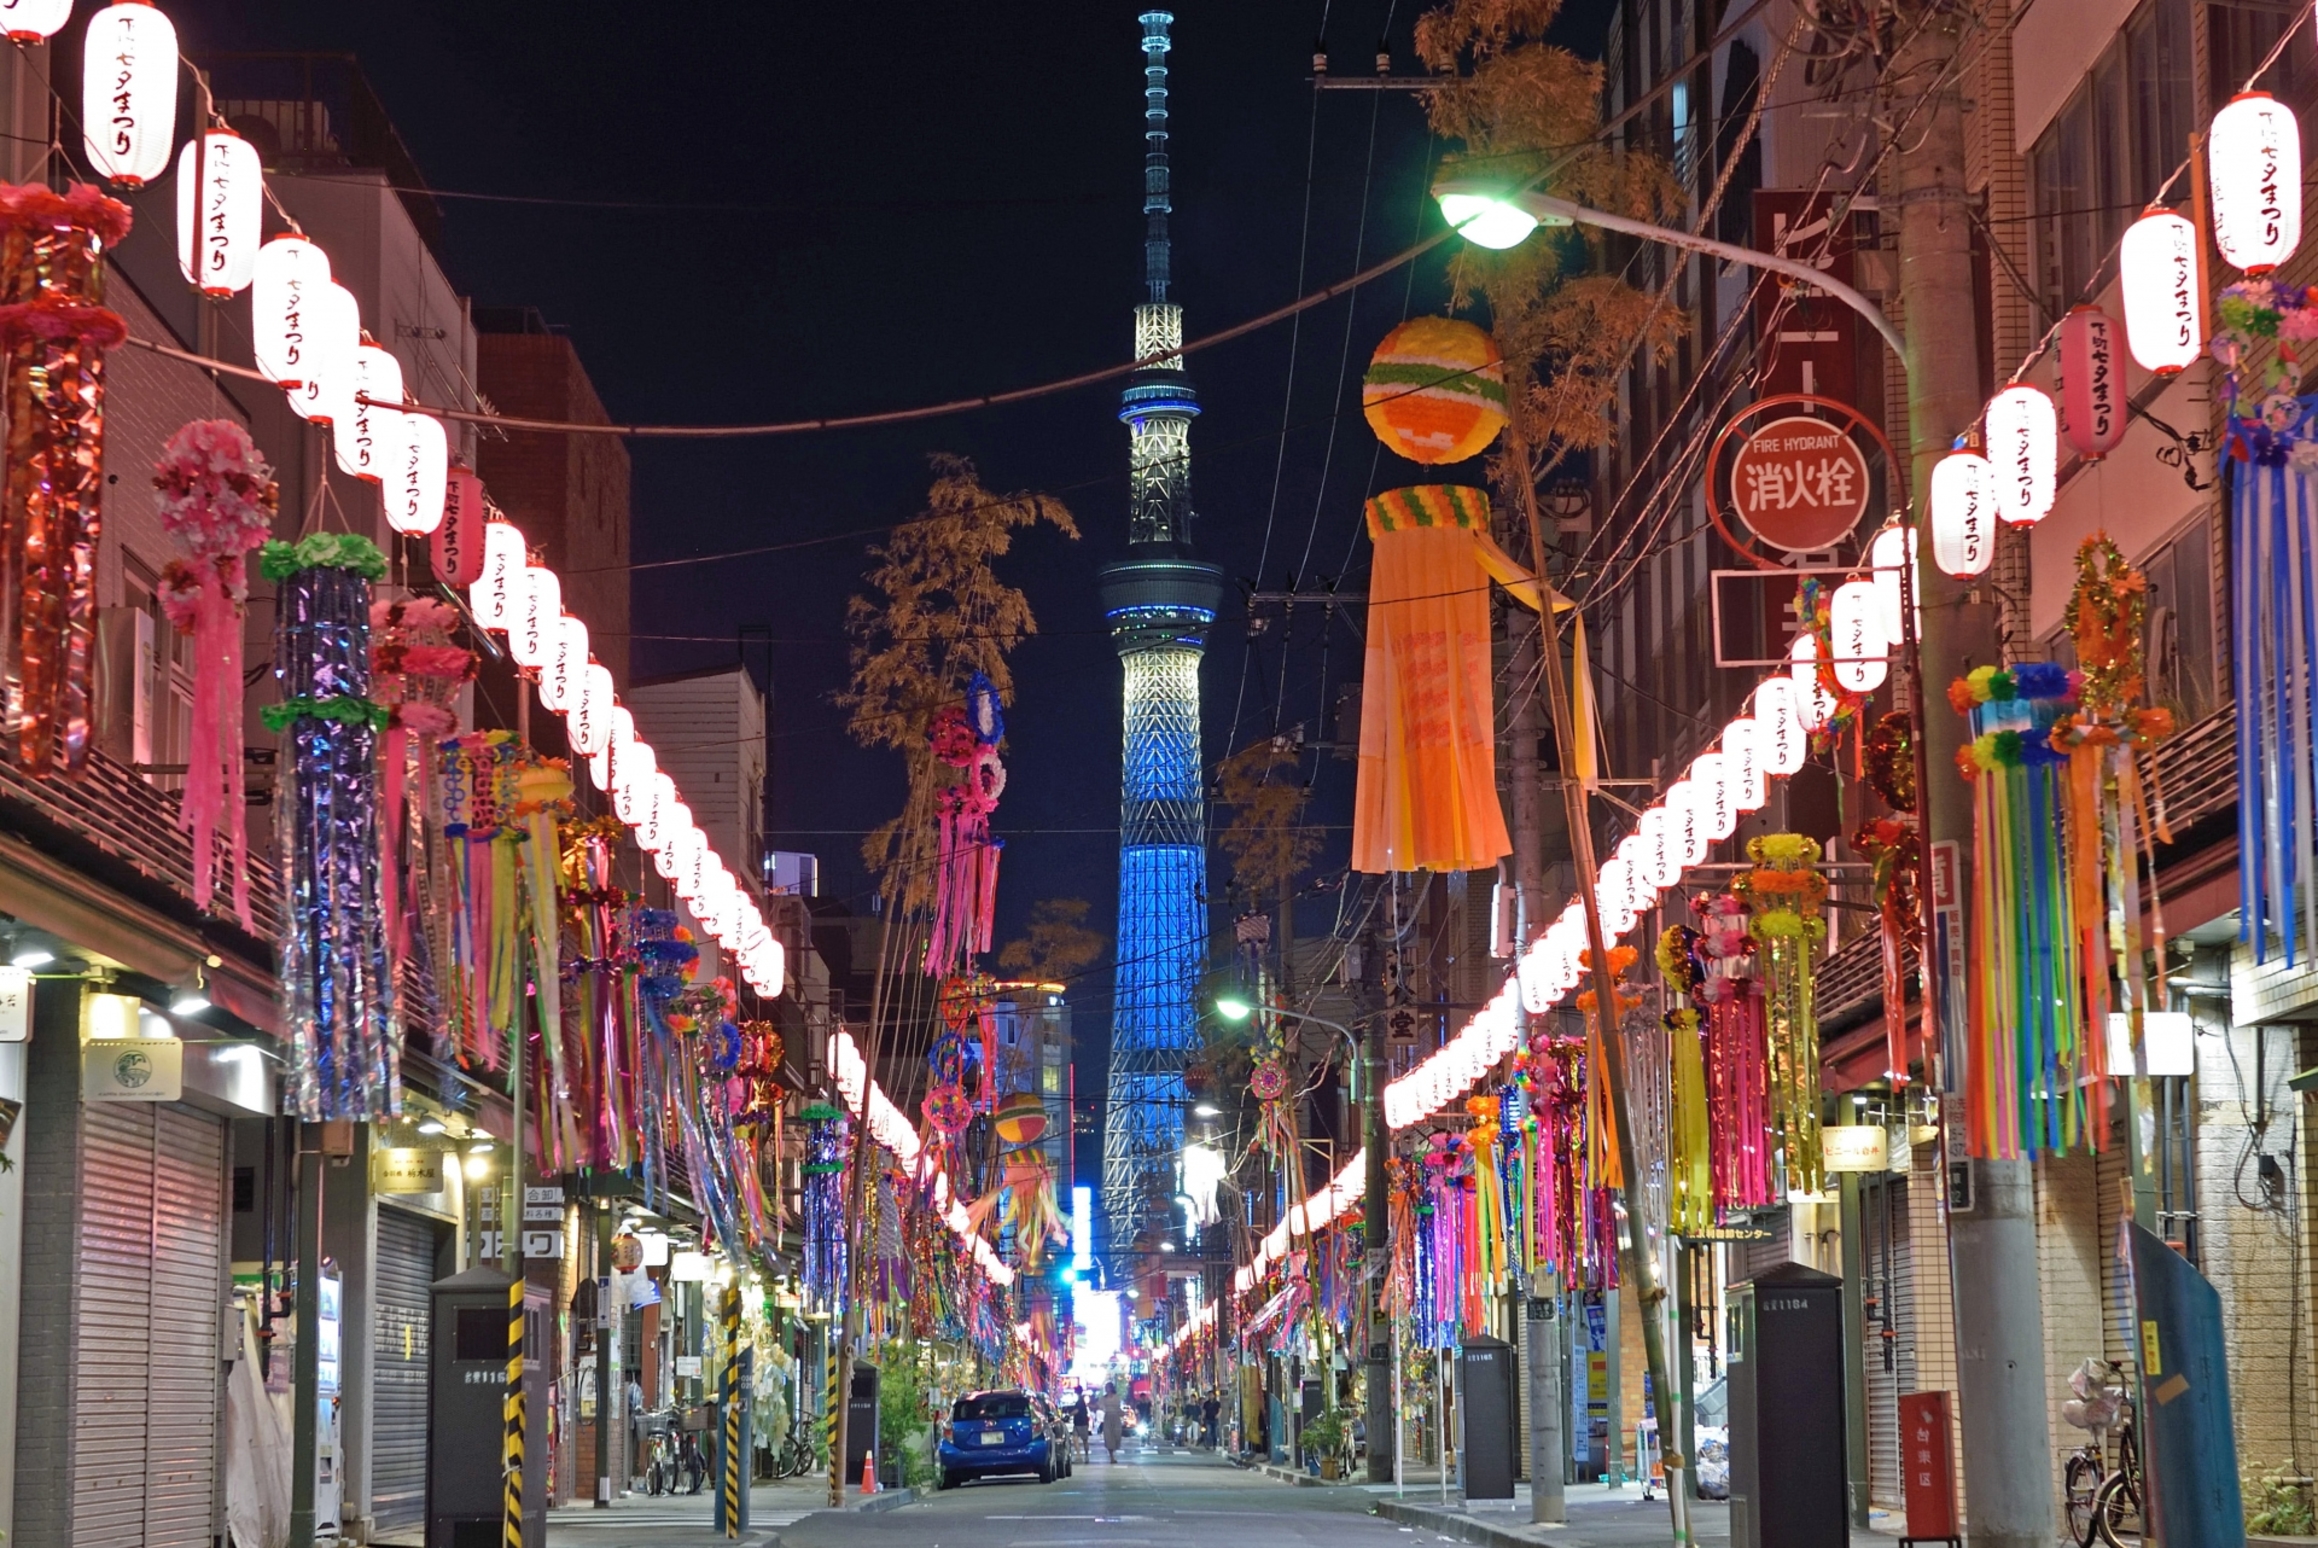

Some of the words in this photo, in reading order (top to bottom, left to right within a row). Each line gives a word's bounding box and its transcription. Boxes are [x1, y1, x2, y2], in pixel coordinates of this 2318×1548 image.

[111, 17, 136, 157] 下七夕まつり
[283, 249, 304, 366] 下七夕まつり
[405, 420, 421, 517] 下七夕まつり
[1746, 459, 1856, 512] 消火栓
[1753, 438, 1779, 454] FIRE
[1784, 436, 1840, 452] HYDRANT
[2014, 399, 2034, 508] 下七夕まつり
